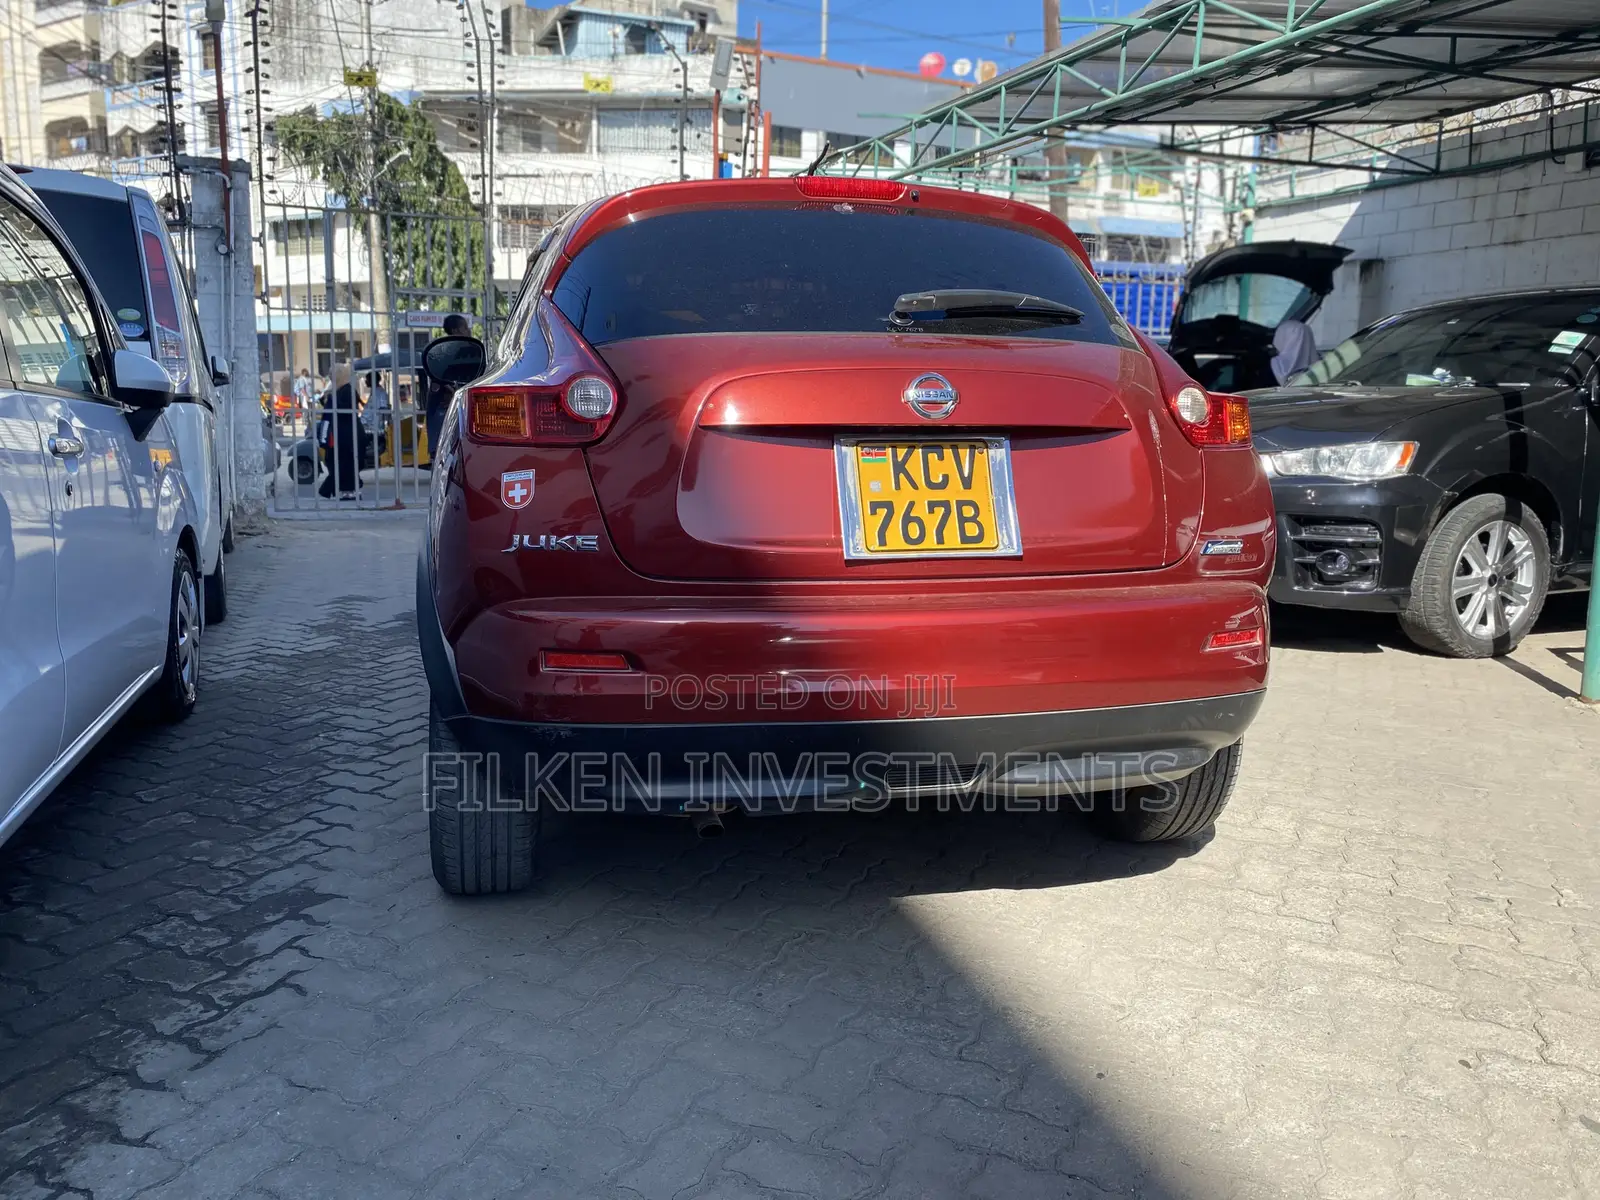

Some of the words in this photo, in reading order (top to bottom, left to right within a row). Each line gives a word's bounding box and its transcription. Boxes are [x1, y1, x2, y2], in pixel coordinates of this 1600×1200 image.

[912, 389, 954, 400] NISSAN
[889, 444, 977, 491] KCV
[868, 499, 985, 547] 767B
[501, 534, 599, 553] JUKE
